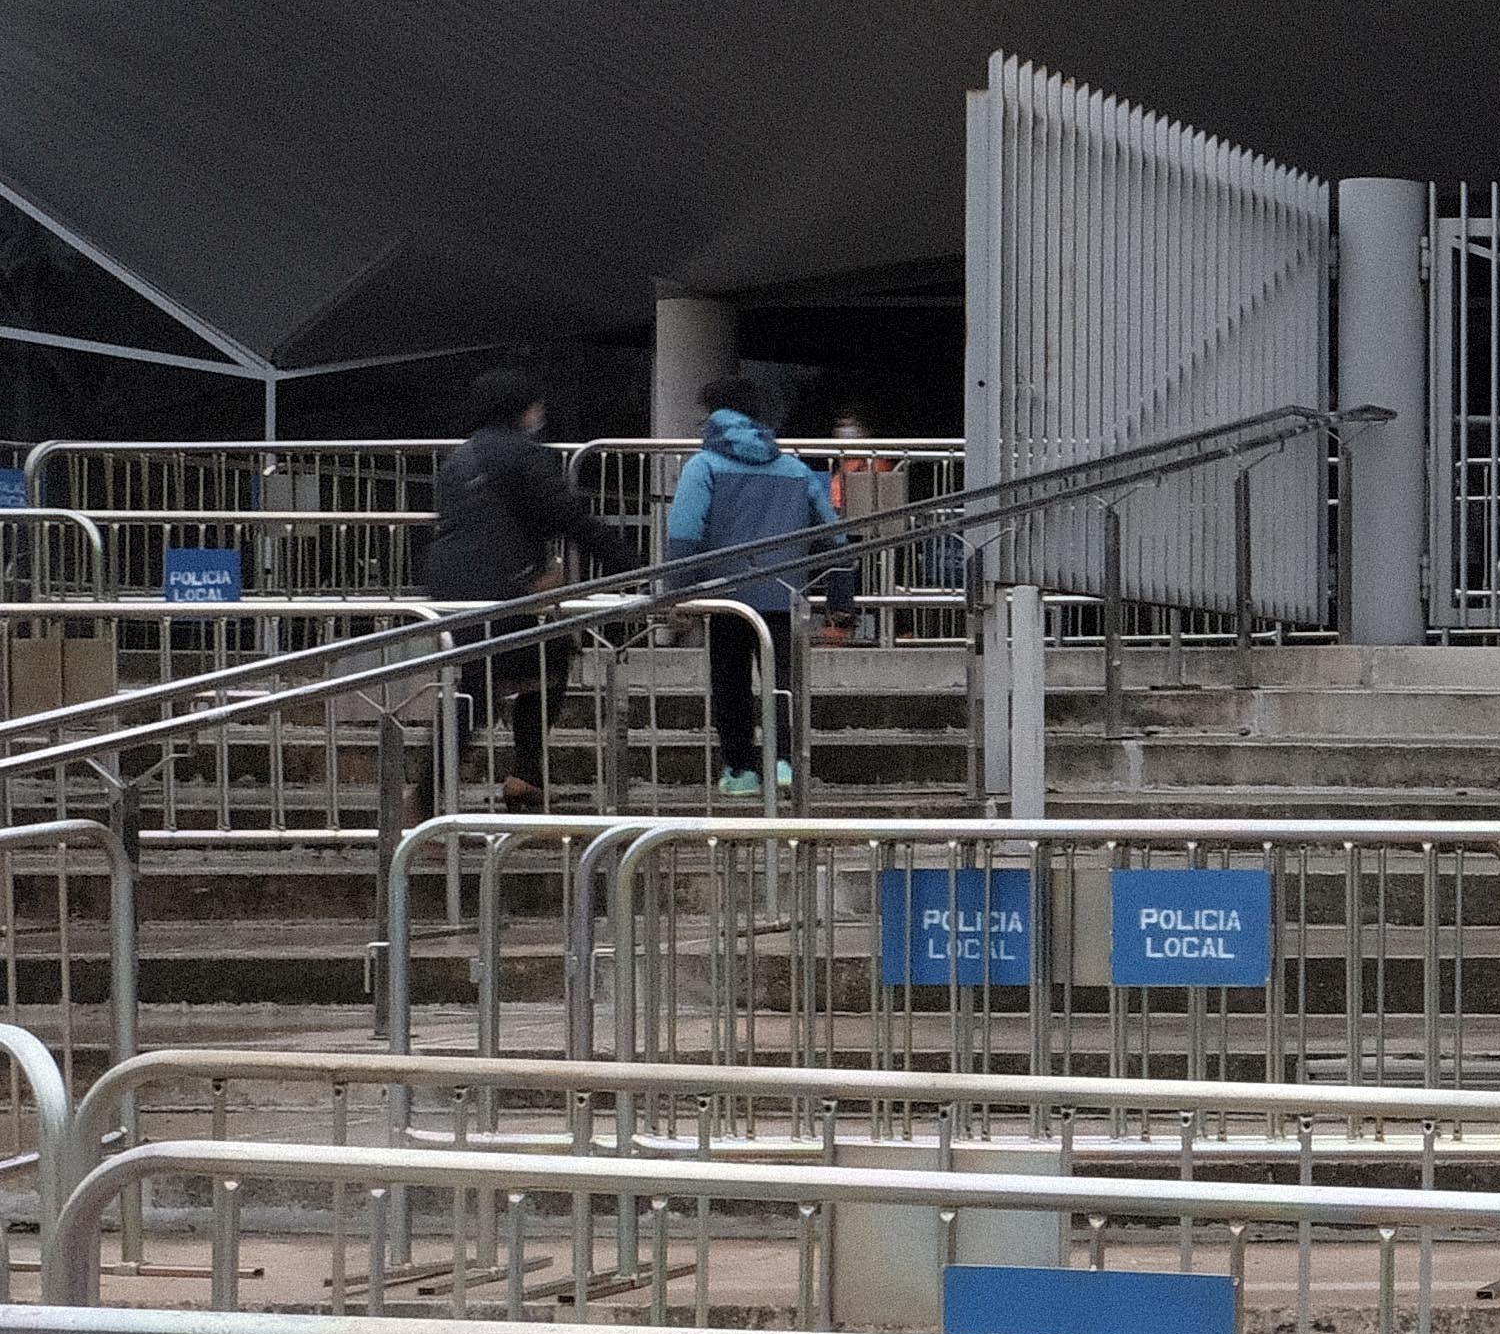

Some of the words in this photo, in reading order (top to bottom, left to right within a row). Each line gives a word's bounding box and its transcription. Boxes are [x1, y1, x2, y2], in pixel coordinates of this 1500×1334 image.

[169, 570, 232, 586] POLICIA
[173, 587, 228, 602] LOCAL
[1140, 908, 1241, 931] POLICIA
[1145, 937, 1235, 958] LOCAL
